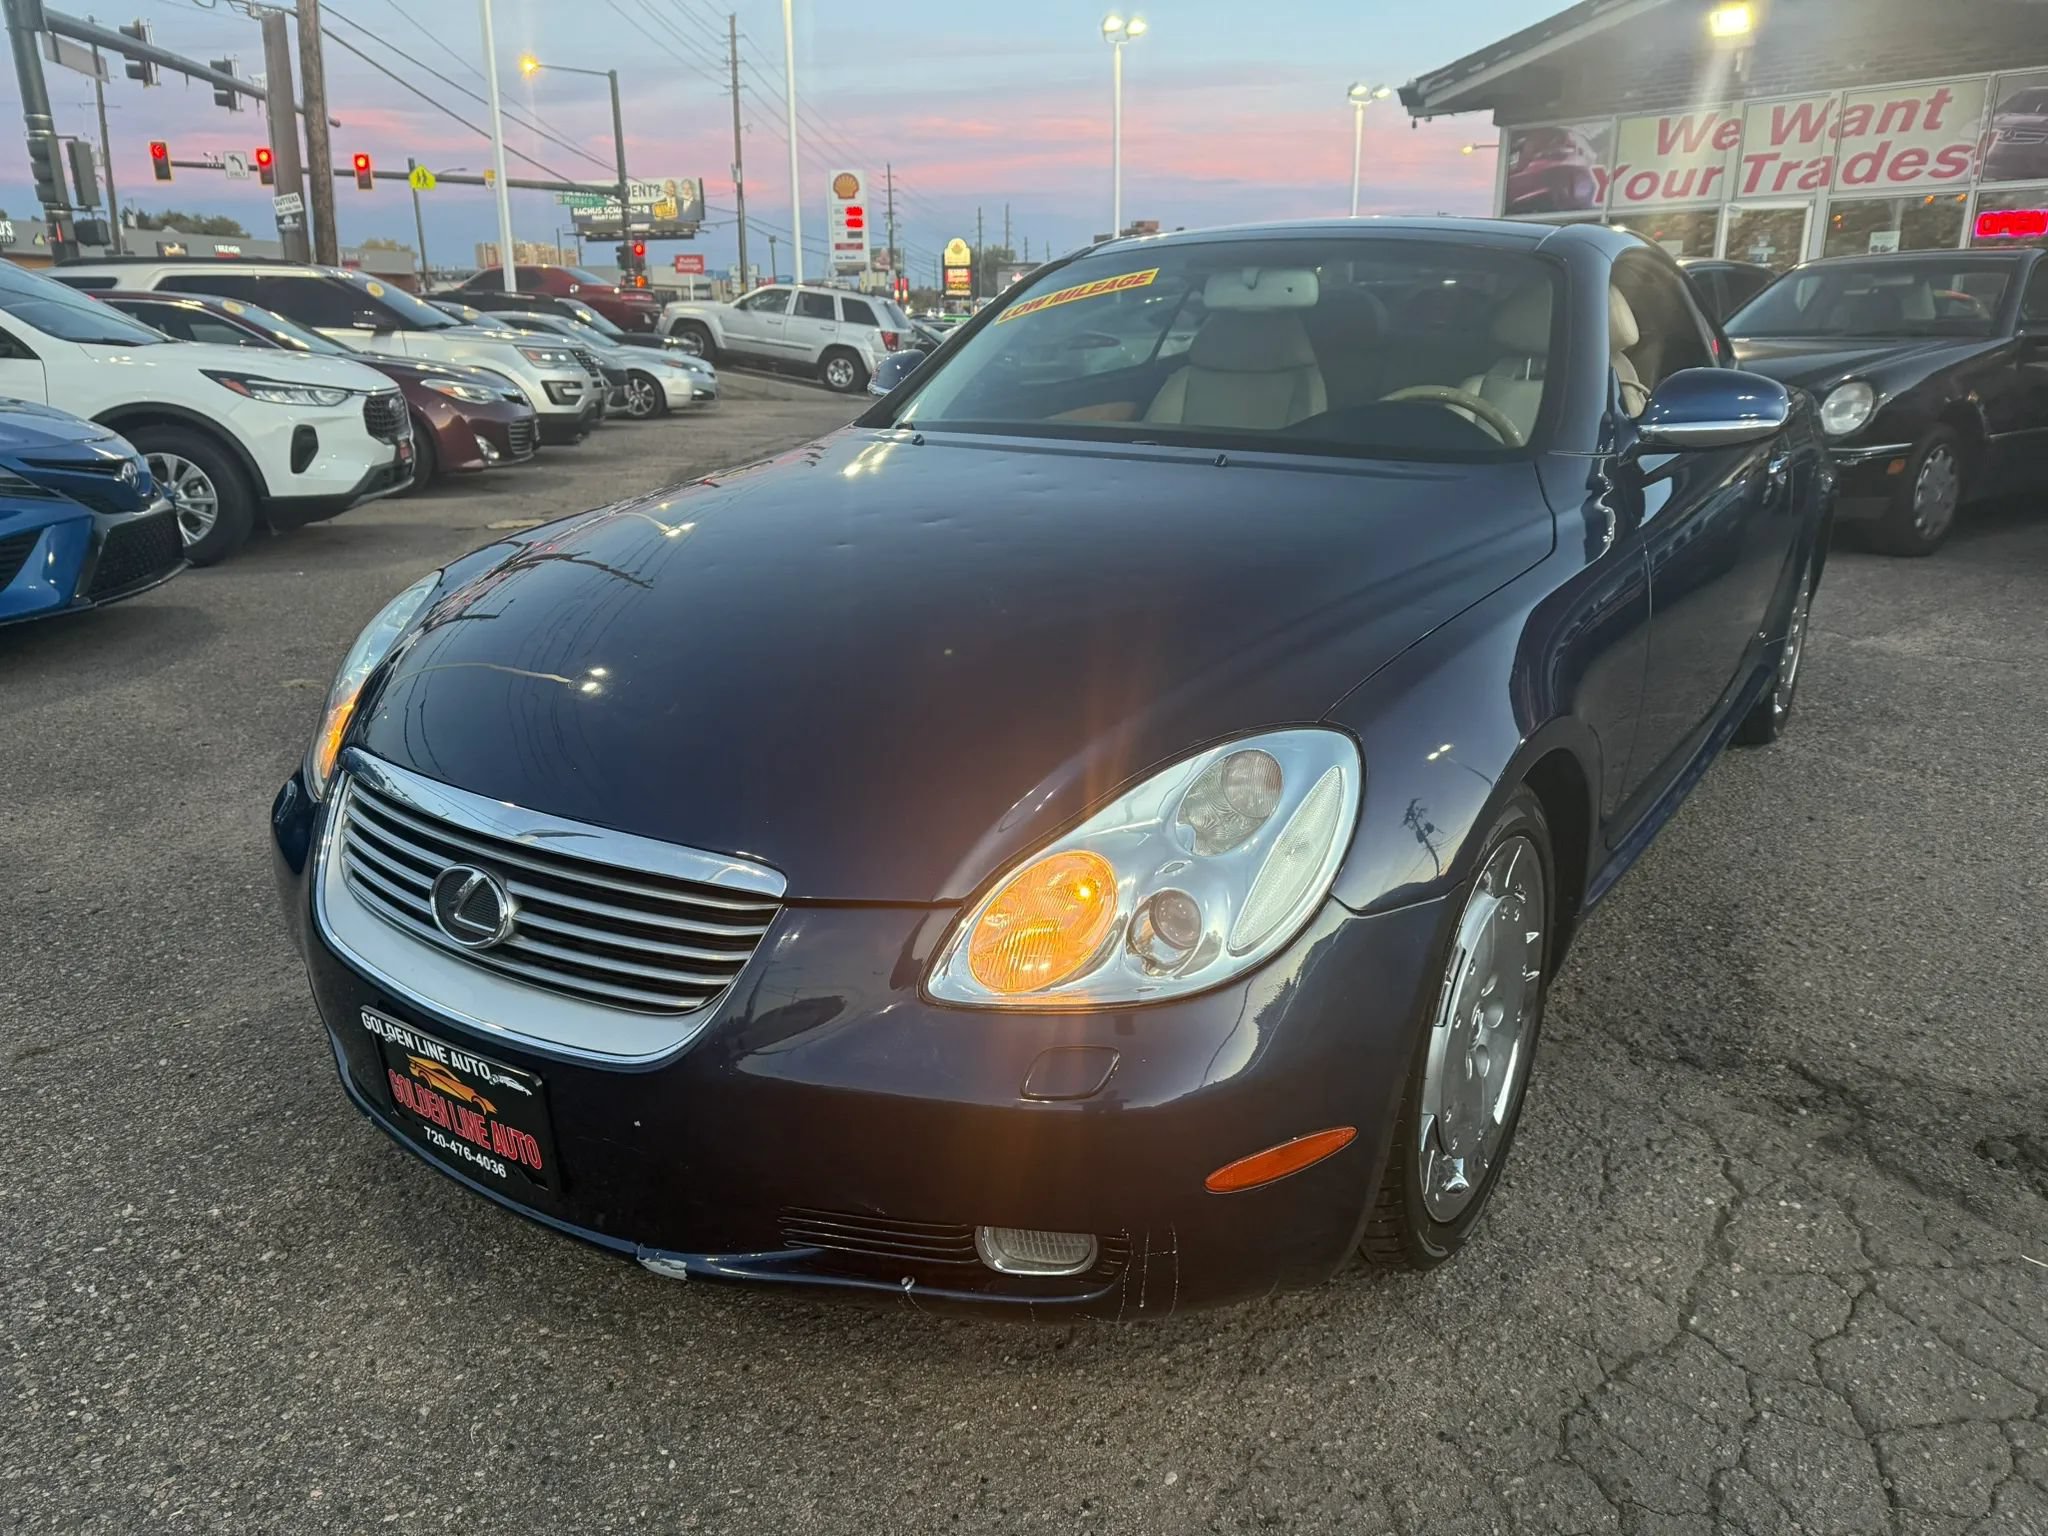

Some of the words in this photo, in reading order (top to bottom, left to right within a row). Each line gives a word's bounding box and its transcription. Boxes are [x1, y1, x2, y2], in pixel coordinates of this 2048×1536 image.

[1657, 115, 1741, 156] We
[1770, 87, 1953, 147] Want
[1591, 163, 1726, 203] Your
[1743, 131, 1998, 194] Trades!
[1000, 298, 1047, 320] LOW
[1048, 271, 1155, 304] MILEAGE
[361, 1012, 414, 1051] GOLDEN
[415, 1036, 449, 1065] LINE
[451, 1050, 491, 1081] AUTO
[388, 1068, 450, 1129] GOLDEN
[449, 1100, 491, 1150] LINE
[491, 1120, 543, 1170] AUTO
[424, 1126, 507, 1178] 720-476-4036
